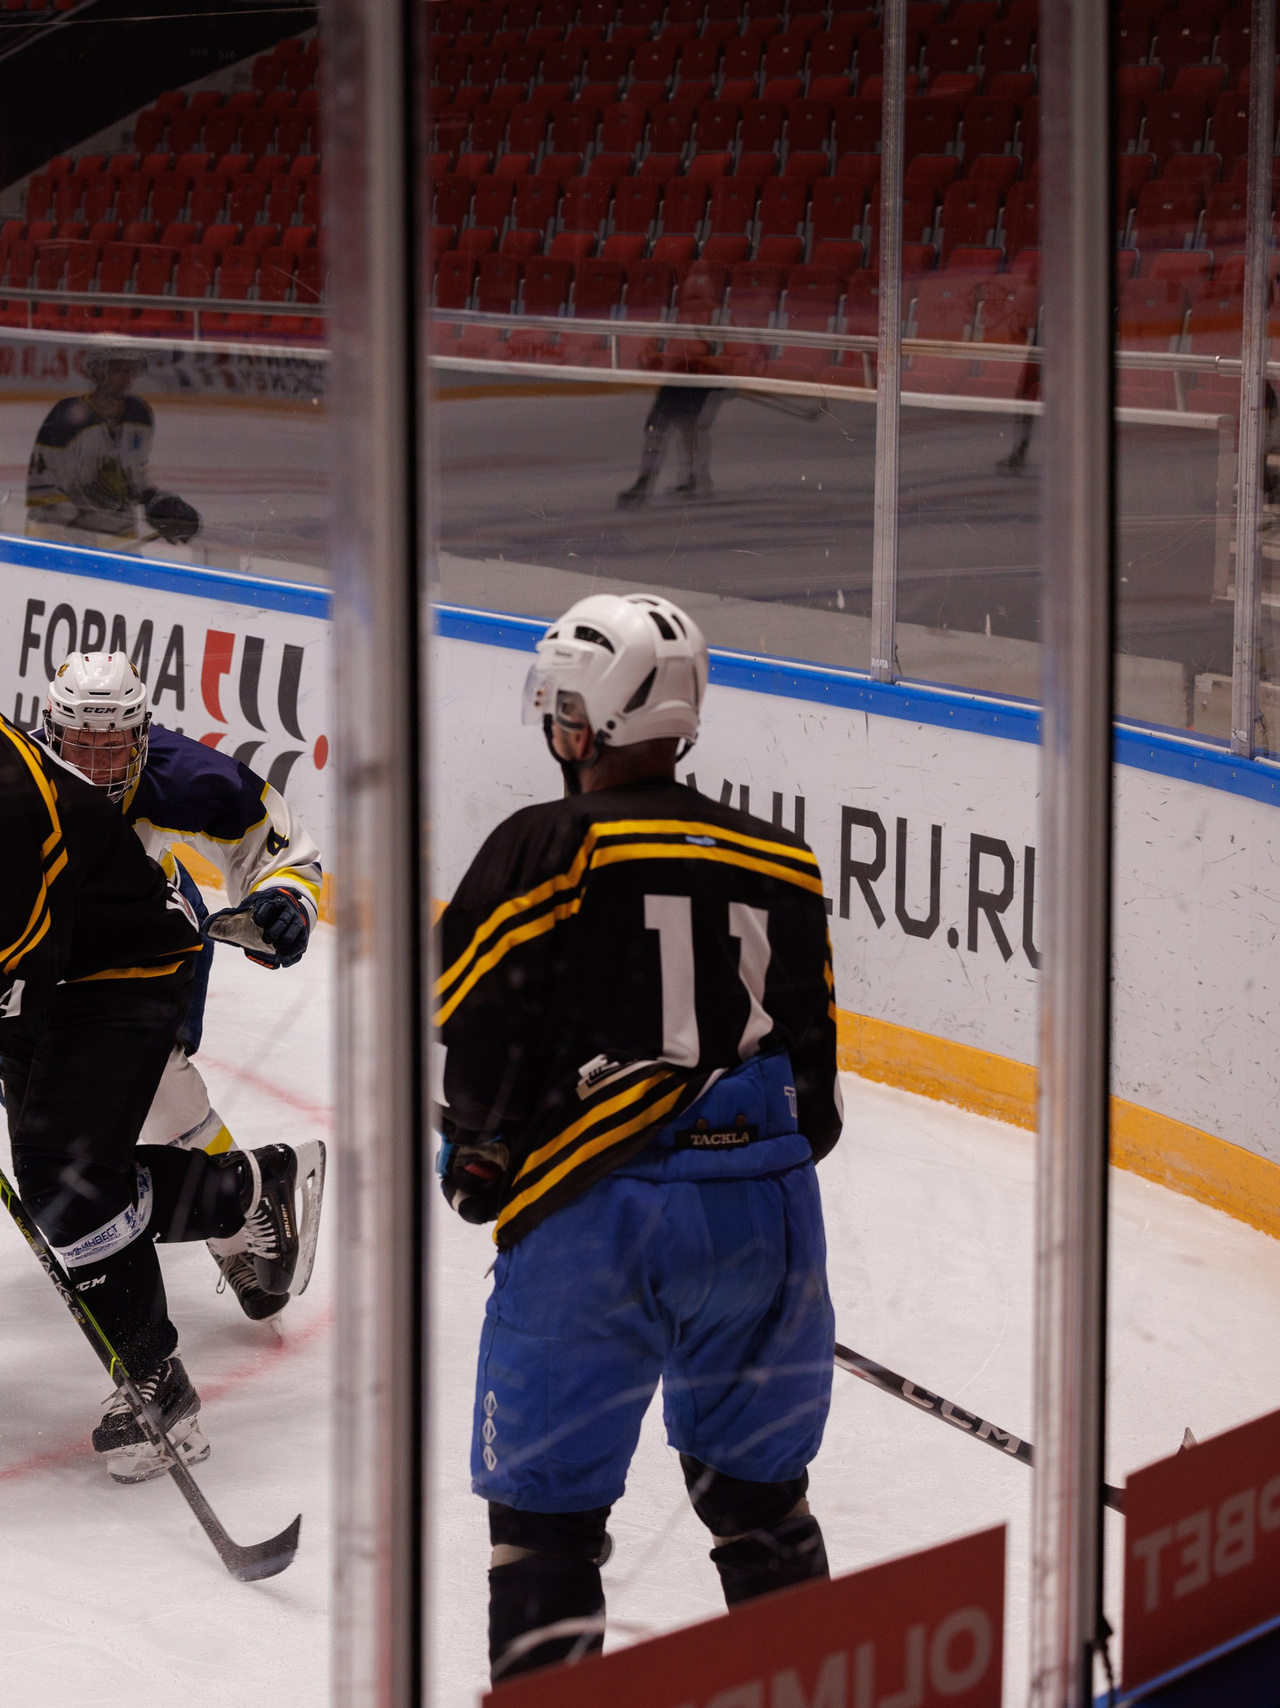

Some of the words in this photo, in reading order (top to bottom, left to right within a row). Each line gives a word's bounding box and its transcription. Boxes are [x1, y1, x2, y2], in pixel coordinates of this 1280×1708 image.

[83, 706, 118, 714] CCM
[644, 894, 773, 1068] 11
[690, 1131, 750, 1146] TACKLA
[15, 1216, 38, 1250] SUPER
[39, 1247, 75, 1306] TACKS
[76, 1275, 107, 1292] CM
[901, 1379, 1022, 1454] CCM
